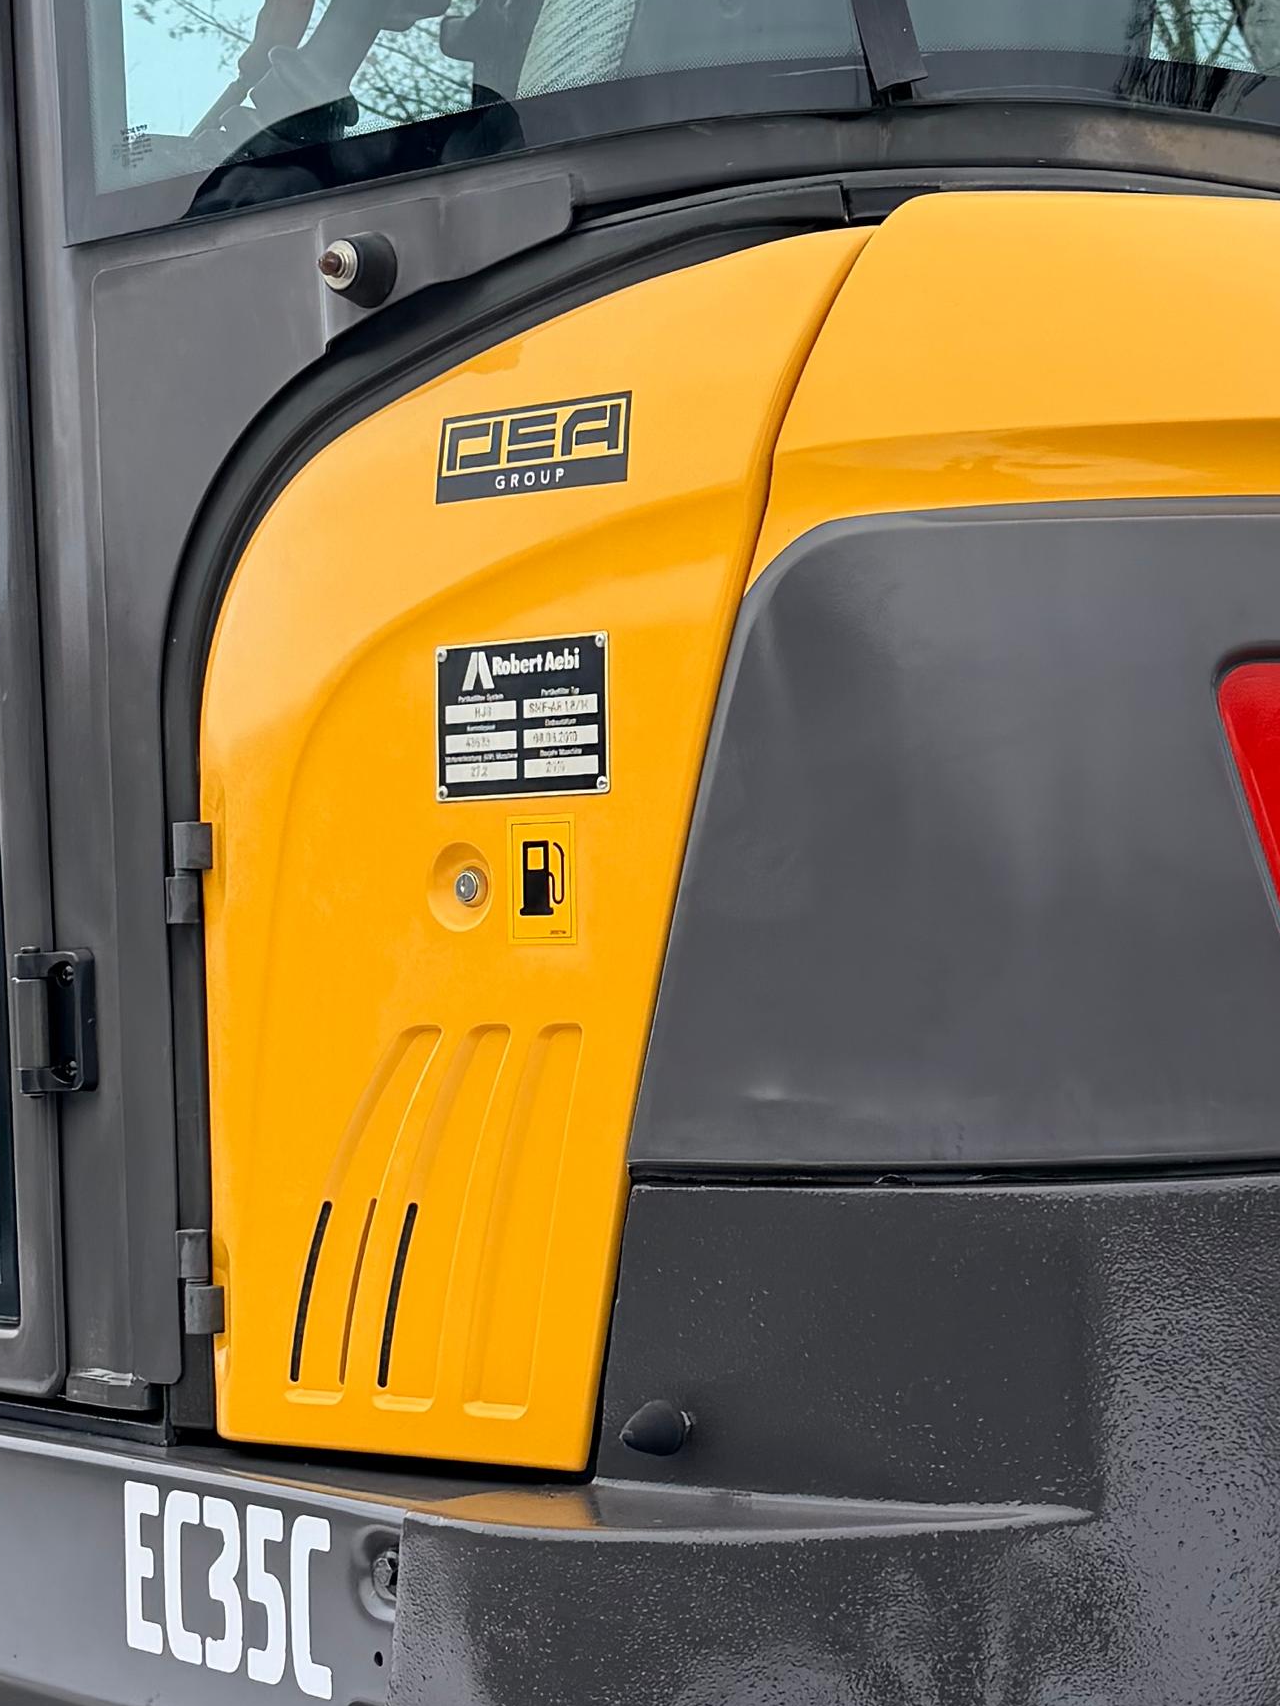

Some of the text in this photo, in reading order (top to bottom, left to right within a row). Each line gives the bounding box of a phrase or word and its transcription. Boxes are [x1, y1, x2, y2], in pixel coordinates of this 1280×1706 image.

[495, 468, 565, 490] GROUP
[492, 647, 580, 676] Robert Aebi
[124, 1480, 333, 1701] EC35C
